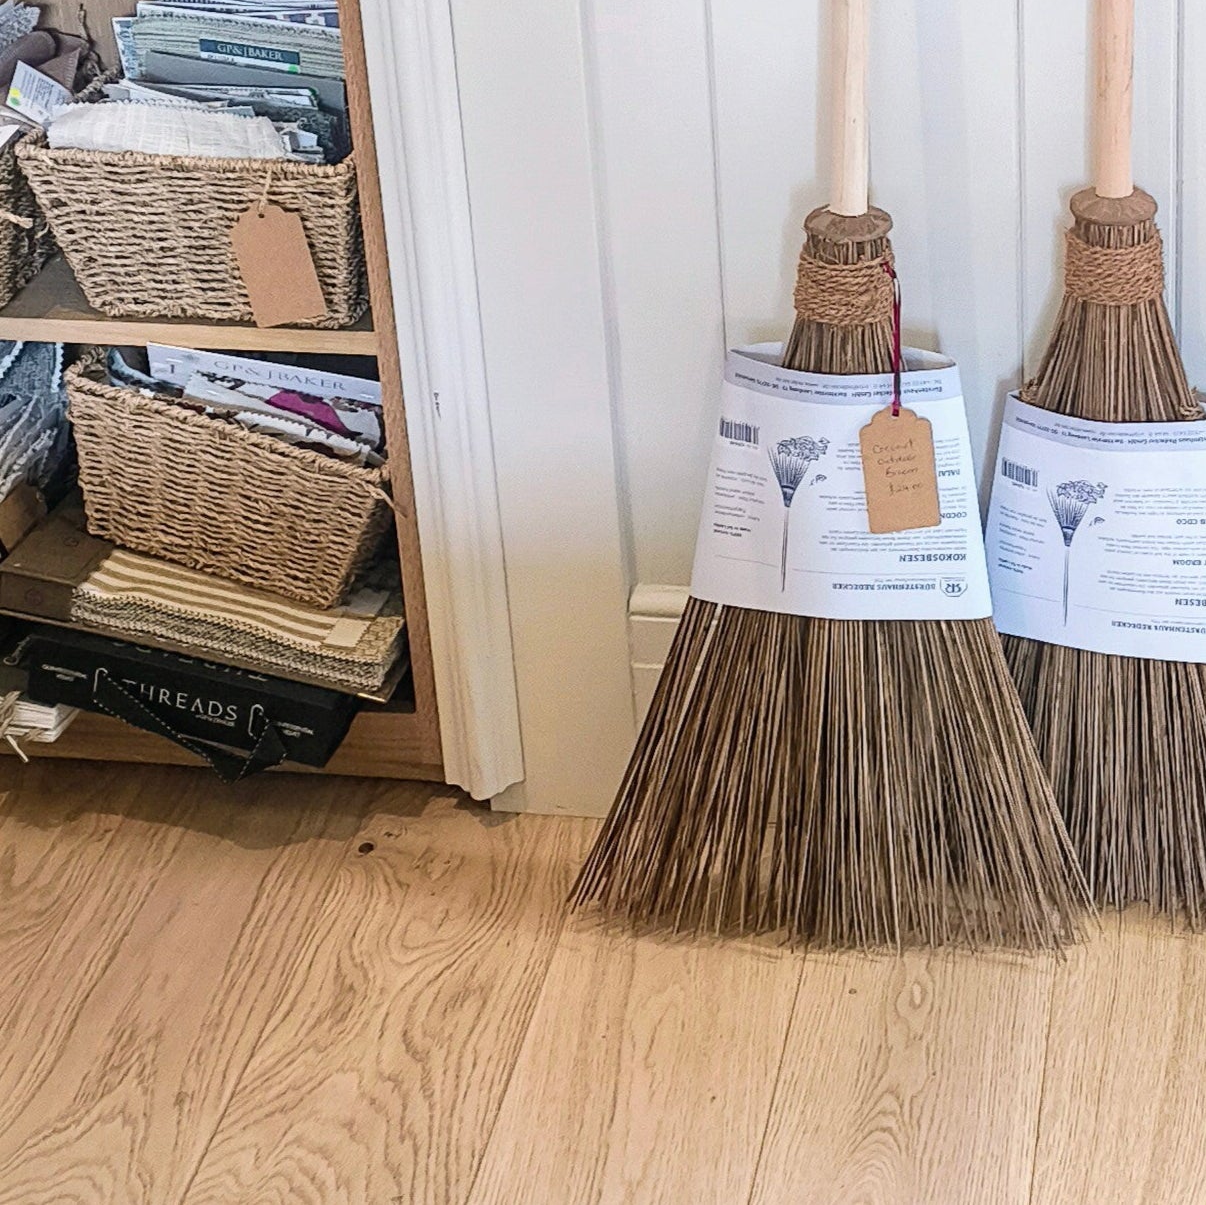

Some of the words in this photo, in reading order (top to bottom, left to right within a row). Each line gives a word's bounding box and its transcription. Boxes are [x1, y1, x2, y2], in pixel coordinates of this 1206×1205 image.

[248, 47, 283, 61] BAKER
[276, 371, 346, 391] BAKER
[899, 553, 967, 562] KOKOSBESEN
[877, 583, 936, 591] BÜRSTENHAUS
[1111, 620, 1152, 630] REDECKER
